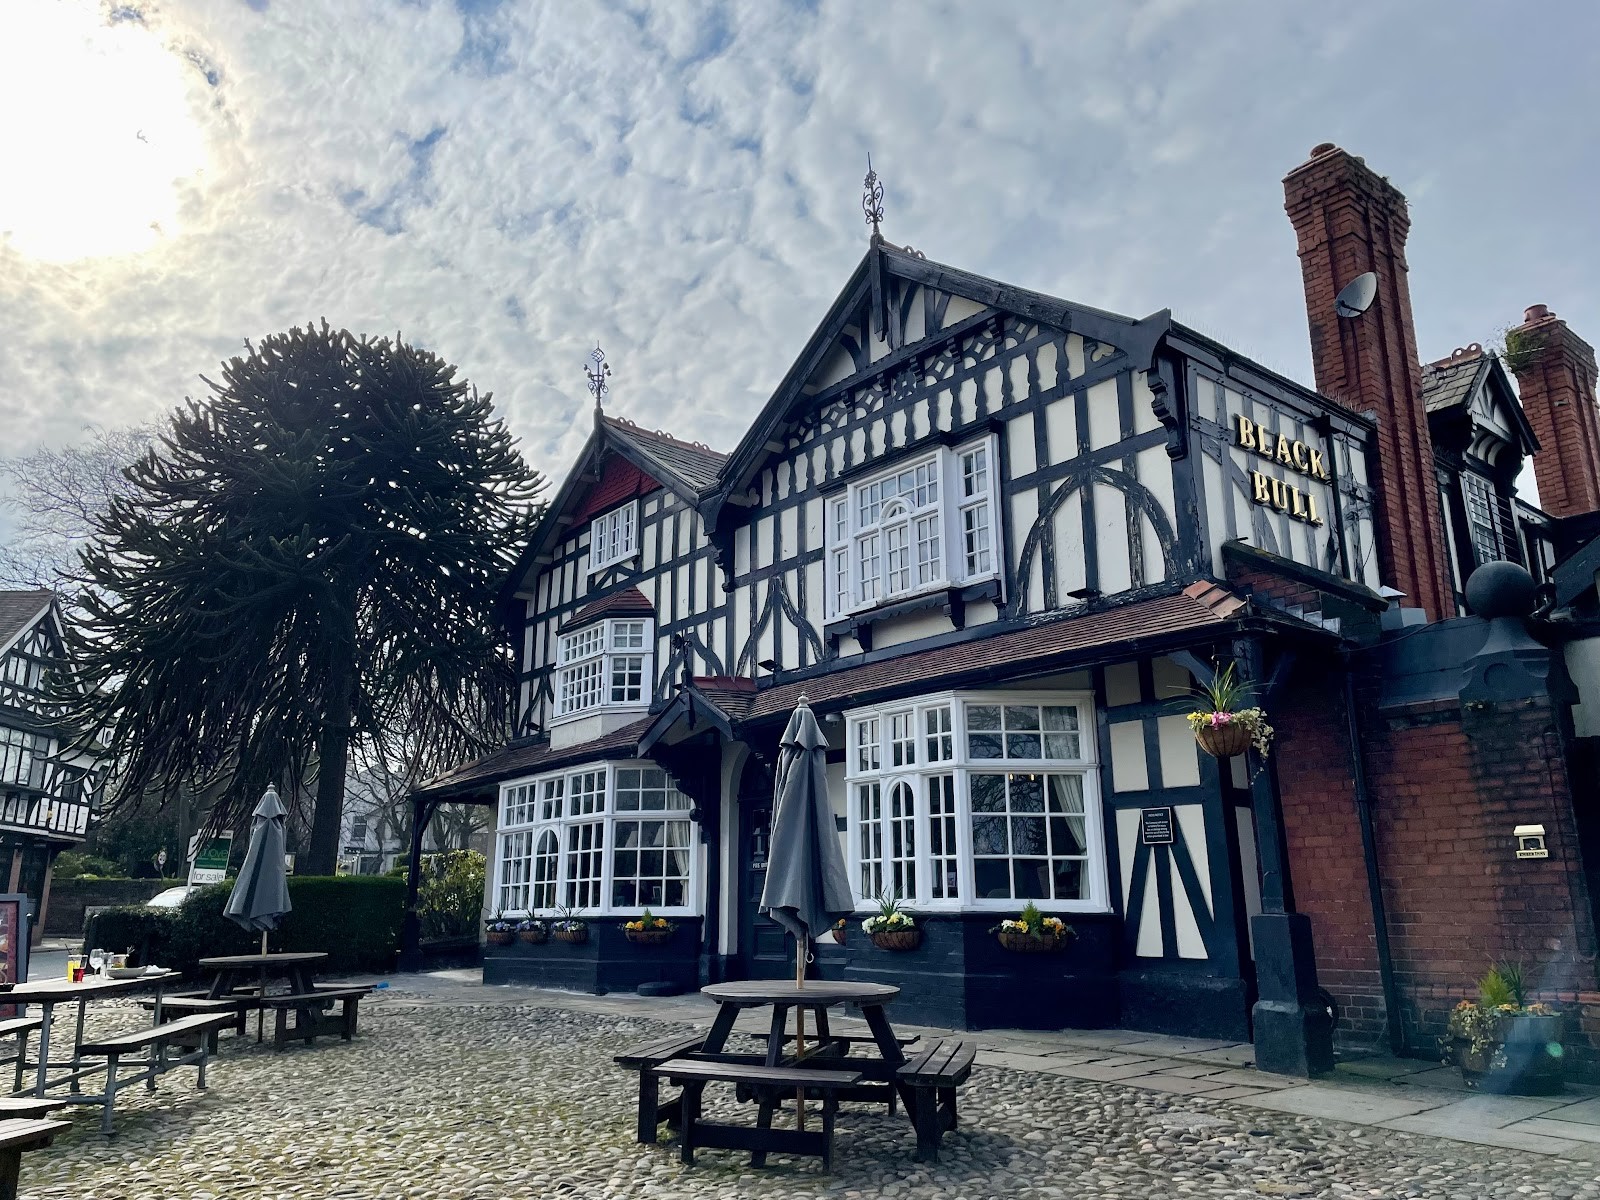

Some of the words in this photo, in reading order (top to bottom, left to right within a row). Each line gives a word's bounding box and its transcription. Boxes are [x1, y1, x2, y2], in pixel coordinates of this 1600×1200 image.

[1236, 413, 1329, 480] BLACK
[1251, 469, 1323, 524] BULL
[193, 871, 205, 880] for
[206, 872, 224, 881] sale
